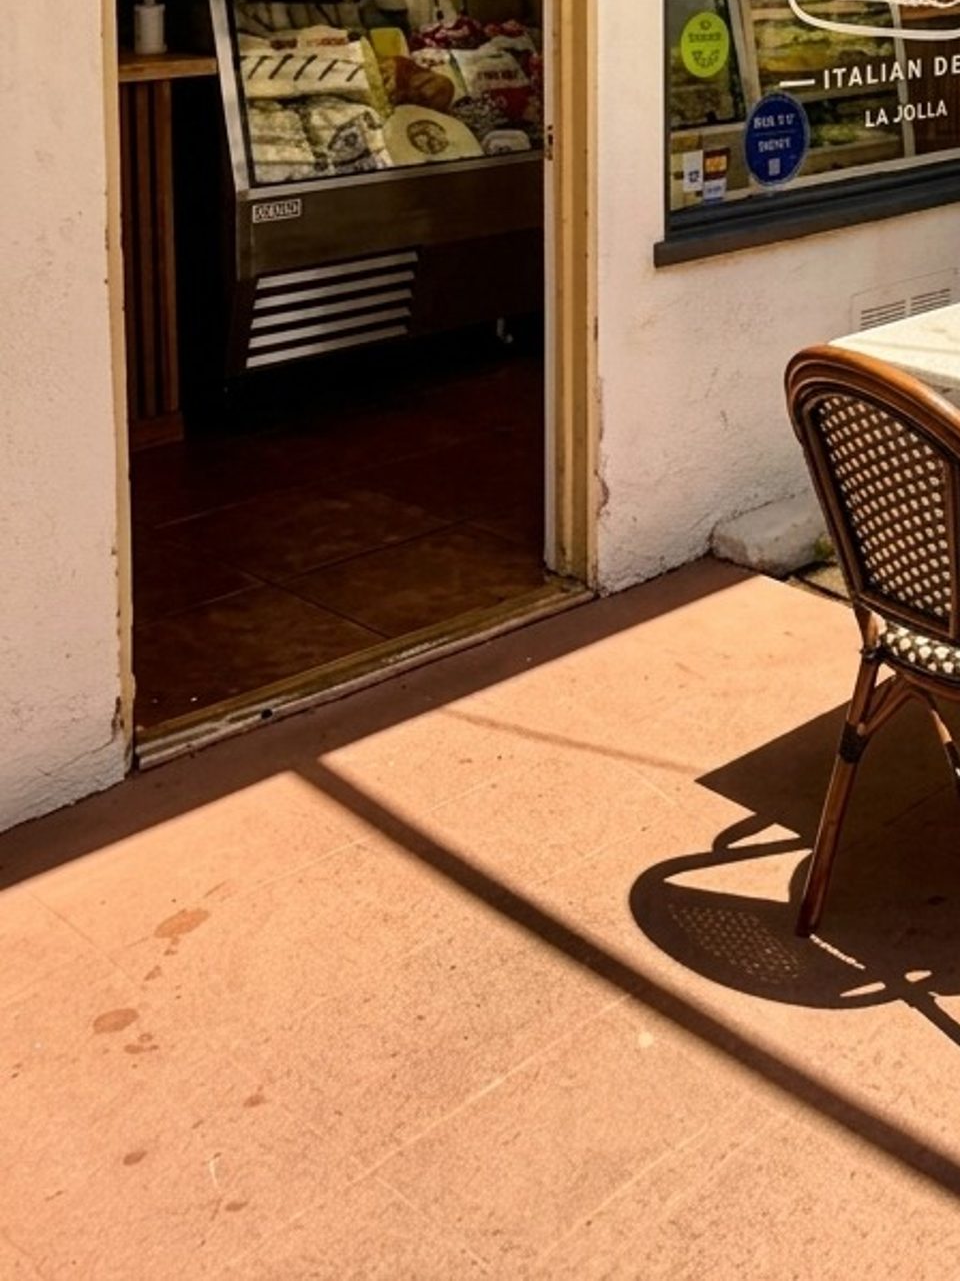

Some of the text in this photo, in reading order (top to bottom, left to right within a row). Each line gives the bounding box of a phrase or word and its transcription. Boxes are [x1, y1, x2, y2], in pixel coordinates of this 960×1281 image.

[824, 58, 922, 89] ITALIAN
[865, 99, 948, 128] LA JOLLA
